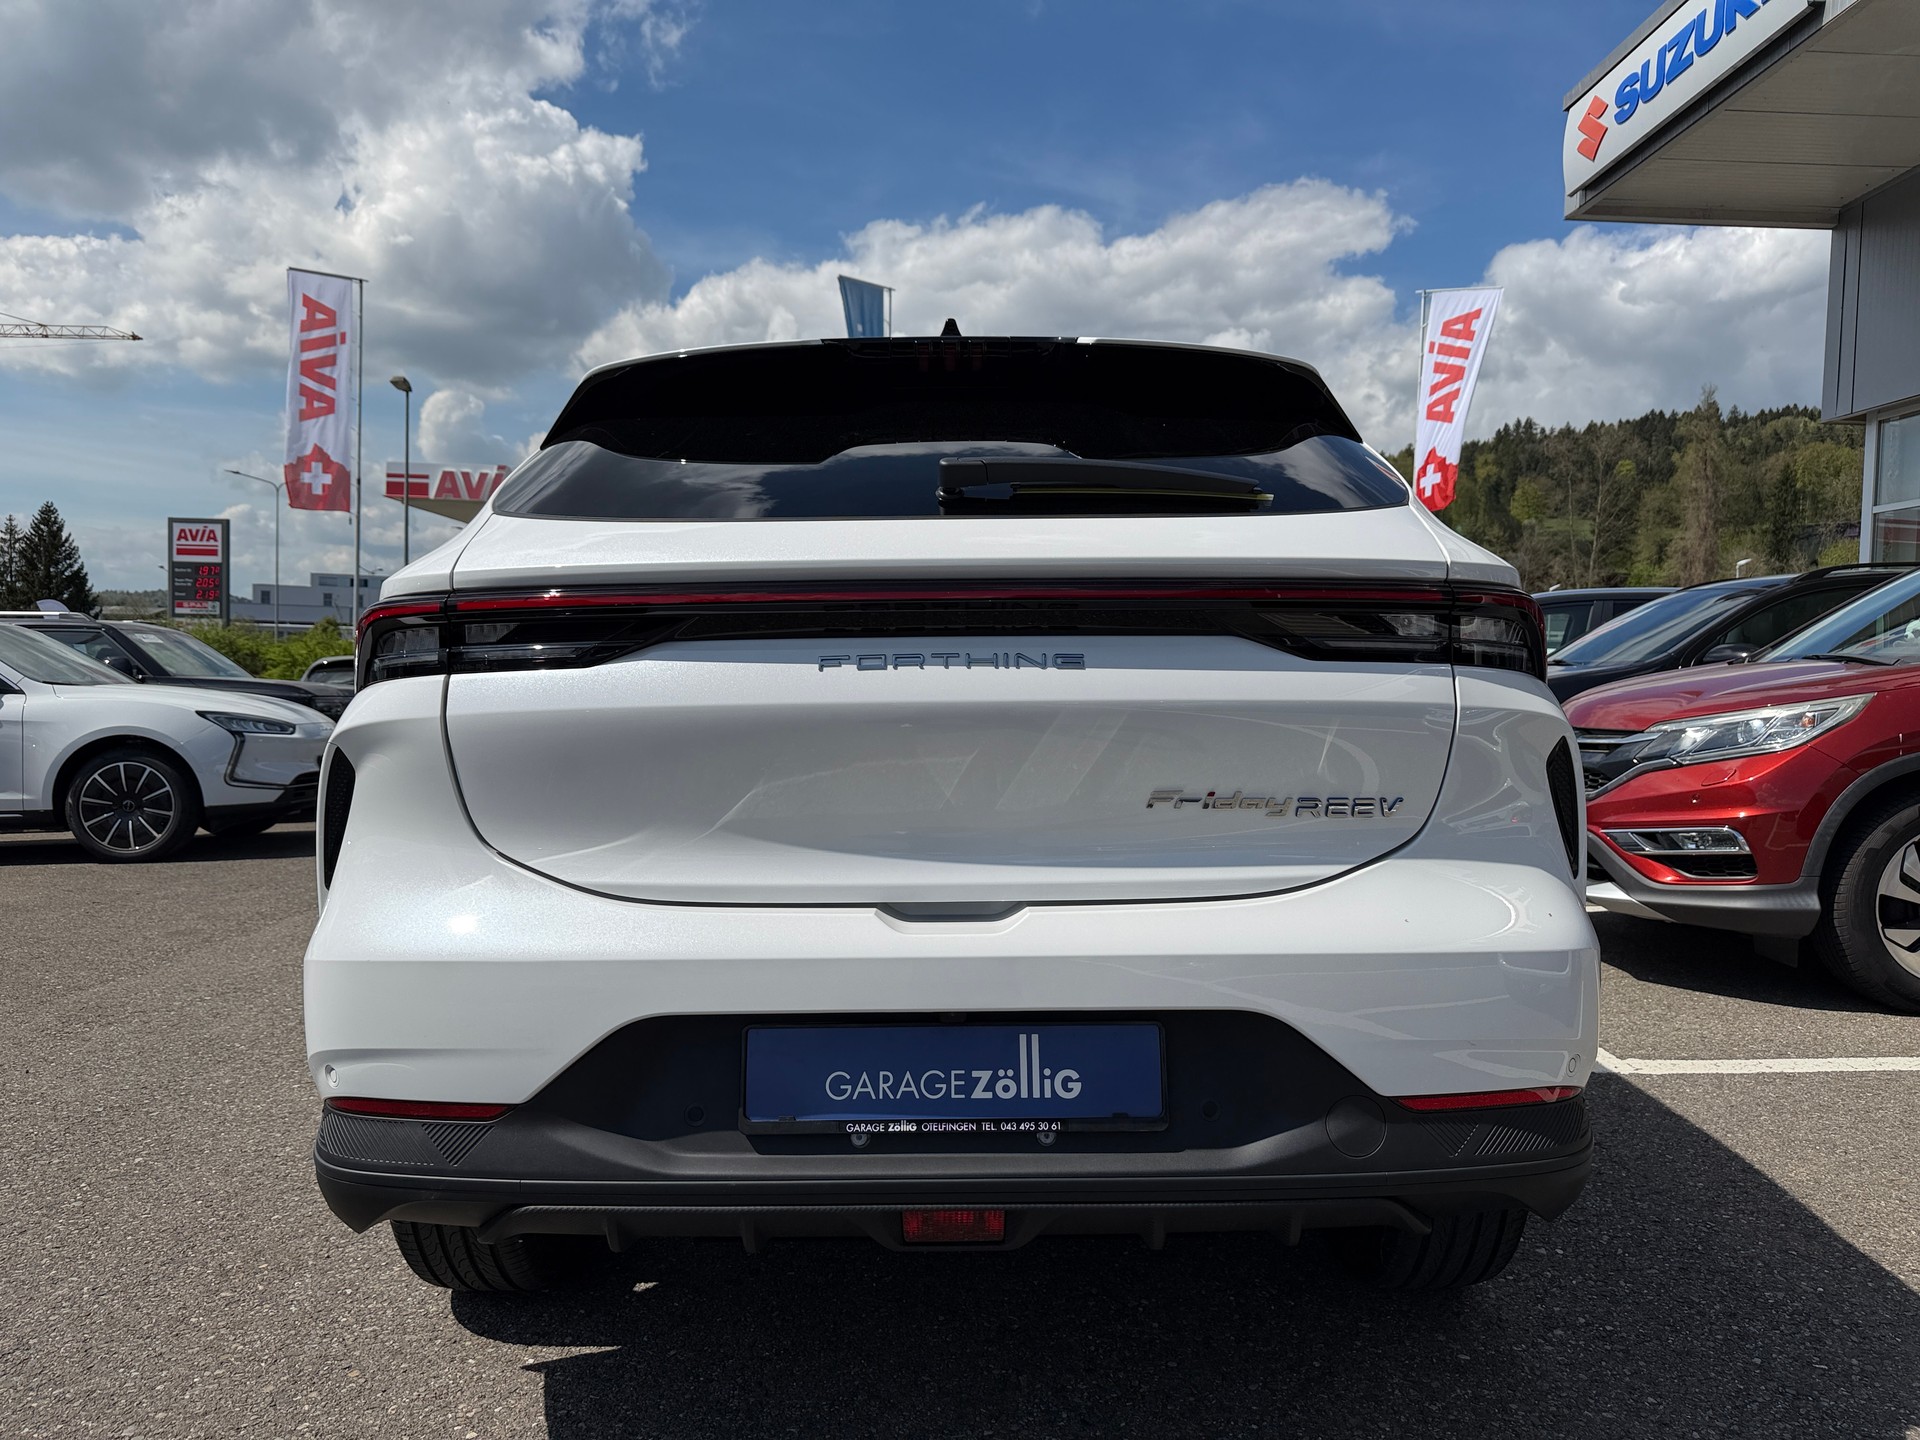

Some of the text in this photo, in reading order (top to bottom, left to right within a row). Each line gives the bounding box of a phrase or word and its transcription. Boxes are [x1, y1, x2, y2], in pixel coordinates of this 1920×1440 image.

[1614, 0, 1769, 125] SUZUK
[818, 653, 1086, 672] FORTHING
[1146, 790, 1404, 818] Friday REEV
[825, 1070, 965, 1100] GARAGE
[846, 1123, 884, 1132] GARAGE
[922, 1122, 976, 1131] OTELFINGEN
[1000, 1121, 1016, 1131] 043
[1019, 1121, 1035, 1131] 495
[1038, 1121, 1049, 1131] 30
[1051, 1121, 1061, 1130] 61
